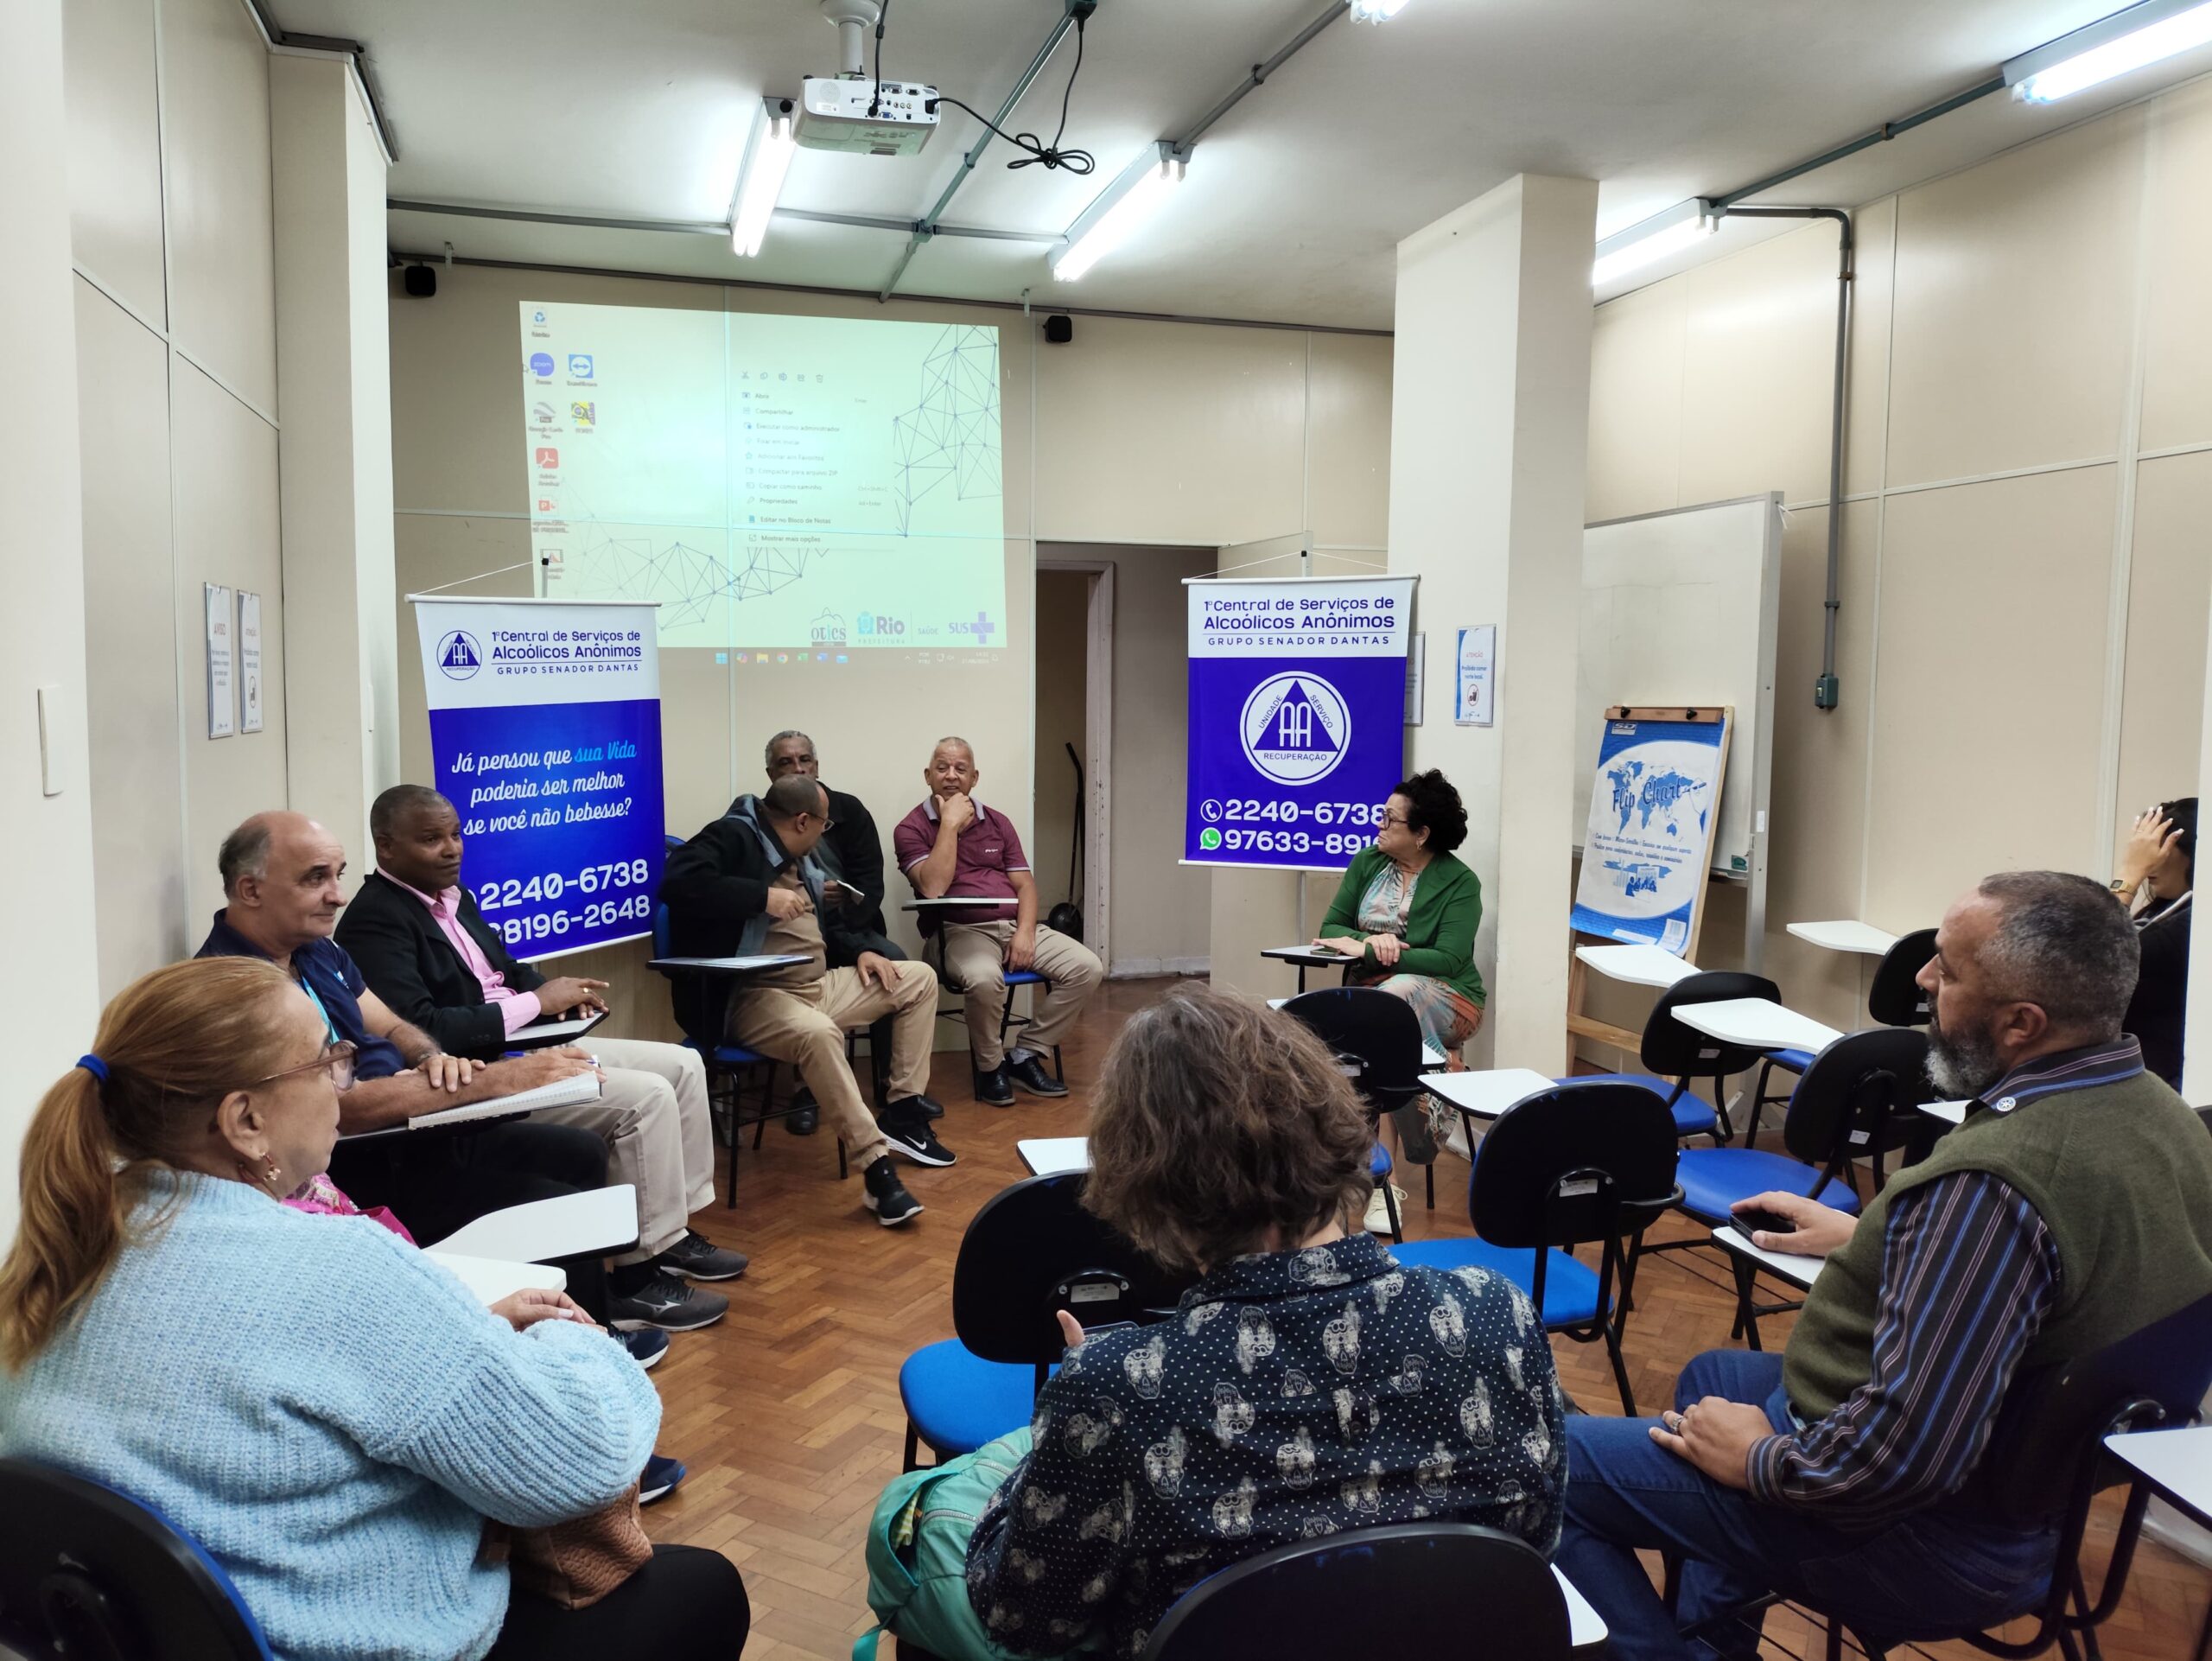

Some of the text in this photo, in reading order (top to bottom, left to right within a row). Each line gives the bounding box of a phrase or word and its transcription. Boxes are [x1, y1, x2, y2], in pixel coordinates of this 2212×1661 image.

[1275, 598, 1294, 611] de
[1300, 597, 1369, 612] Serviços
[1374, 596, 1395, 609] de
[876, 615, 906, 635] Rio
[949, 622, 969, 634] SUS
[1204, 612, 1395, 630] Alcoólicos Anônimos
[553, 631, 568, 642] de
[572, 631, 624, 644] Serviços
[627, 630, 641, 641] de
[1208, 636, 1389, 646] GRUPO SENADOR DANTAS
[492, 644, 570, 659] Alcoólicos
[575, 643, 642, 659] Anônimos
[497, 664, 639, 675] GRUPO SENADOR DANTAS
[1258, 695, 1283, 729] UNIDADE
[1310, 695, 1333, 729] SERVIÇO
[451, 740, 638, 776] Já pensou que sua Vida
[1263, 753, 1327, 762] RECUPERAÇÃO
[470, 771, 626, 808] poderia ser melhor
[1612, 777, 1681, 812] Flip Chart
[463, 797, 632, 836] se você não bebesse?
[1224, 829, 1379, 856] 97633-891
[480, 858, 649, 911] 2240-6738
